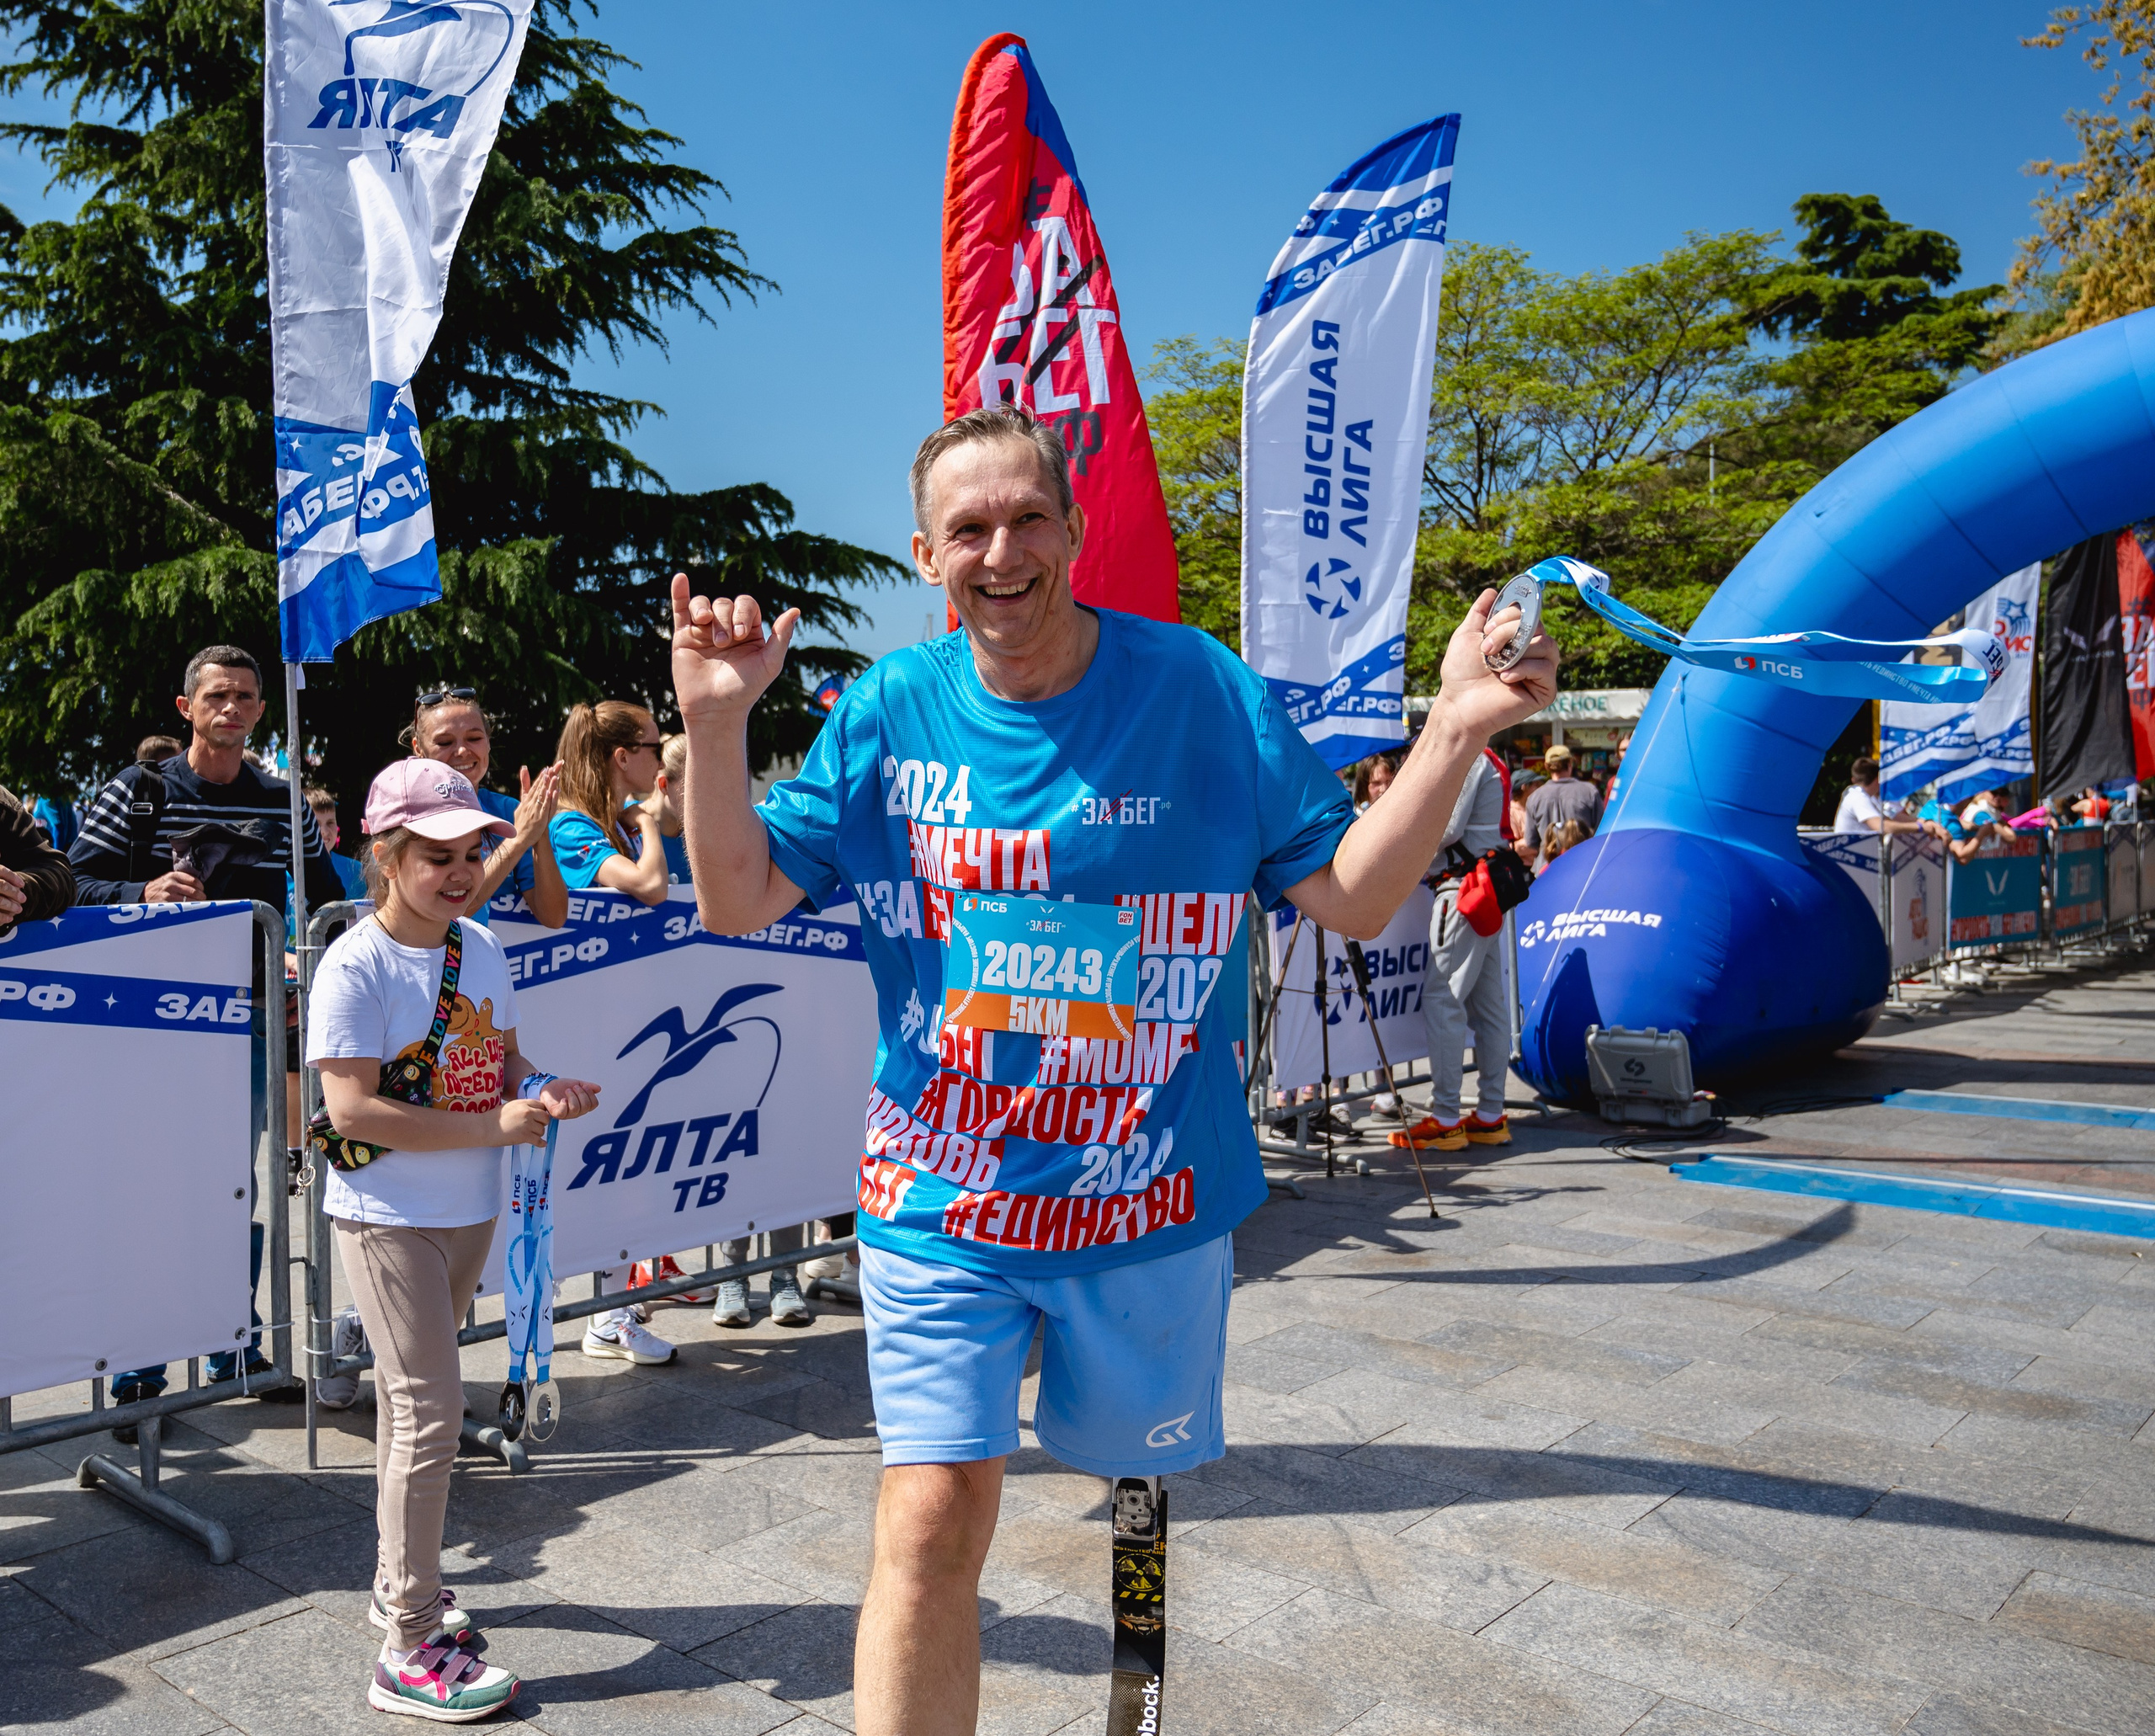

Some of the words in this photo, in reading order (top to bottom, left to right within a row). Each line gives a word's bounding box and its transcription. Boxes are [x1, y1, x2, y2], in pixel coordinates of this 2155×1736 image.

[1303, 320, 1340, 540] ВЫСШАЯ
[1339, 419, 1374, 549] ЛИГА
[1762, 660, 1803, 679] ПСБ
[884, 754, 972, 825] 2024
[910, 821, 1051, 891] #МЕЧТА
[981, 900, 1008, 913] ПСБ
[1551, 908, 1662, 928] ВЫСШАЯ
[1544, 923, 1606, 942] ЛИГА
[443, 945, 461, 993] LOVE
[982, 940, 1104, 995] 20243
[428, 995, 452, 1046] LOVE
[444, 1070, 497, 1096] NEED
[448, 1047, 487, 1072] ALL
[567, 1105, 759, 1191] ЯЛТА
[528, 1179, 537, 1204] ПСБ
[673, 1172, 729, 1213] ТВ
[944, 1167, 1195, 1251] #ЕДИНСТВО
